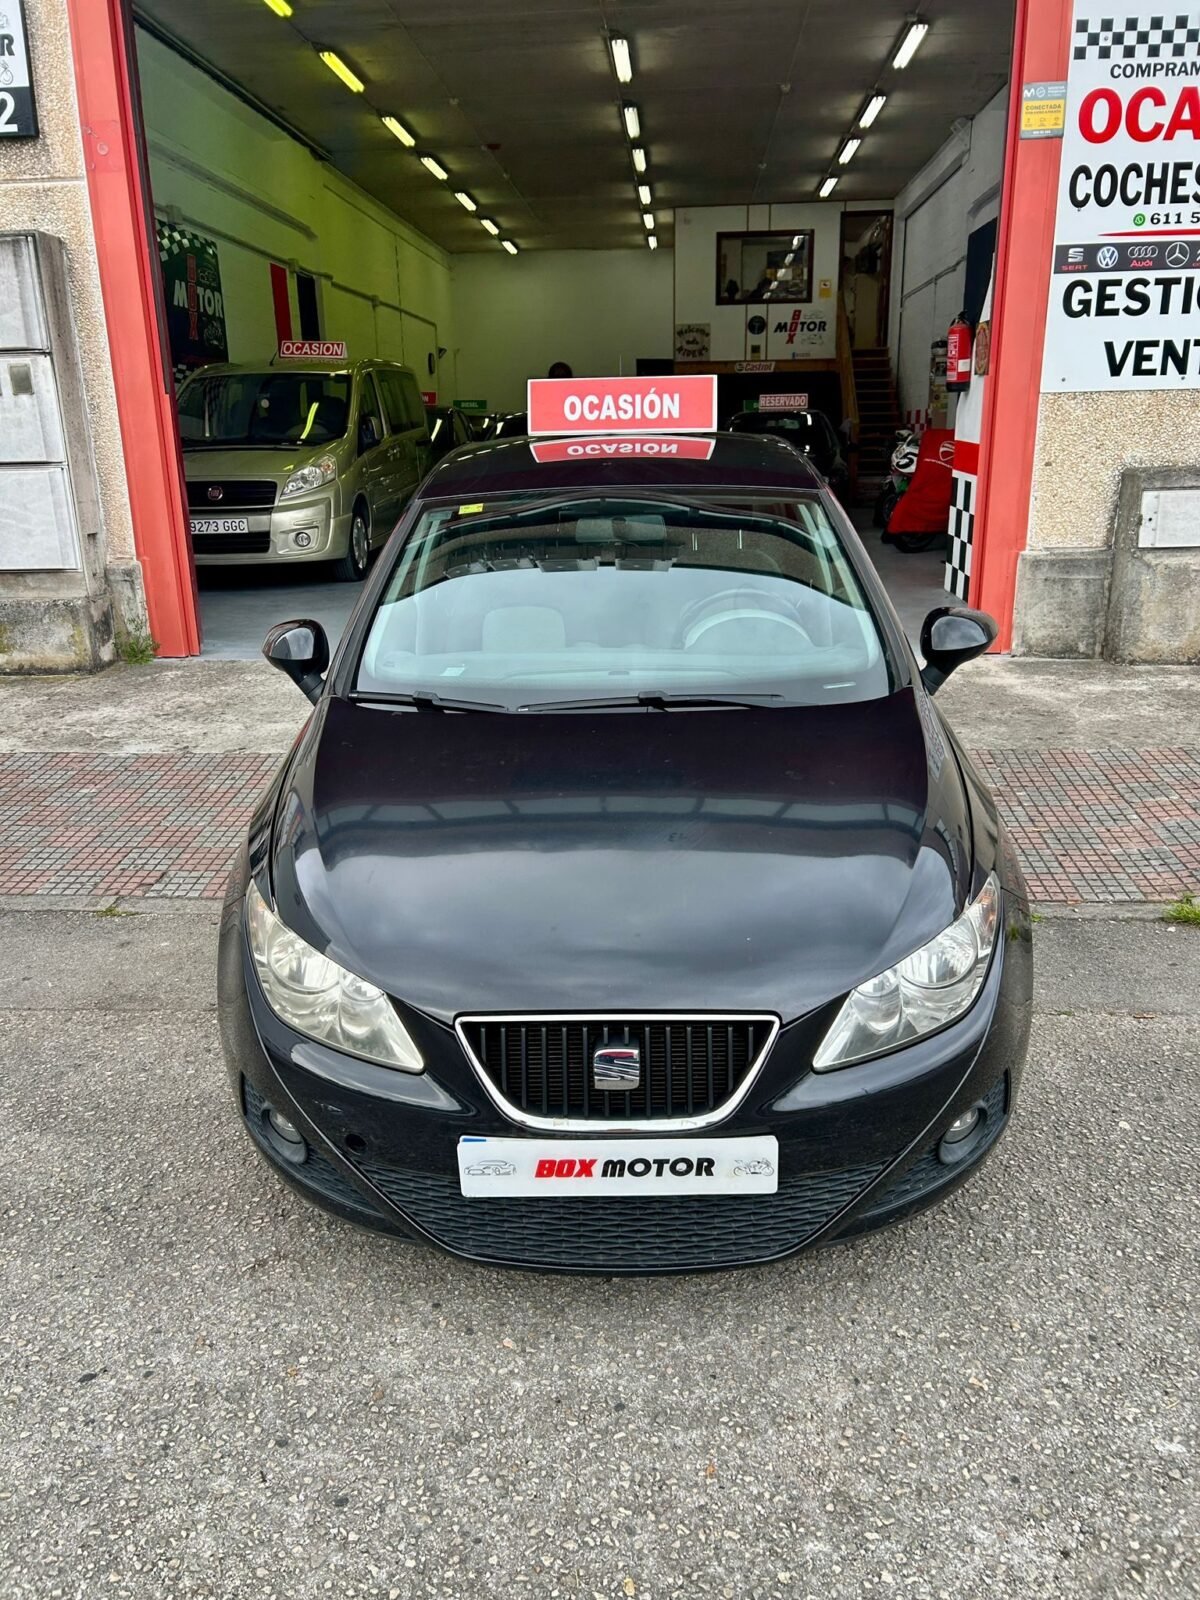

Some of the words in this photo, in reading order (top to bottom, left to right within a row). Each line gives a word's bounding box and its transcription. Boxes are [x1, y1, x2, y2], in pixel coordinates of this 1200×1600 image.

[1078, 86, 1200, 143] OCA
[1150, 213, 1183, 225] 611
[1130, 259, 1154, 268] Audi
[1062, 276, 1200, 319] GESTI
[283, 343, 343, 355] OCASION
[744, 363, 773, 371] Castrol
[563, 387, 681, 421] OCASIÓN
[761, 396, 806, 406] RESERVADO
[190, 521, 219, 533] 9273
[223, 520, 245, 531] GGC
[534, 1158, 598, 1178] BOX
[601, 1157, 716, 1178] MOTOR
